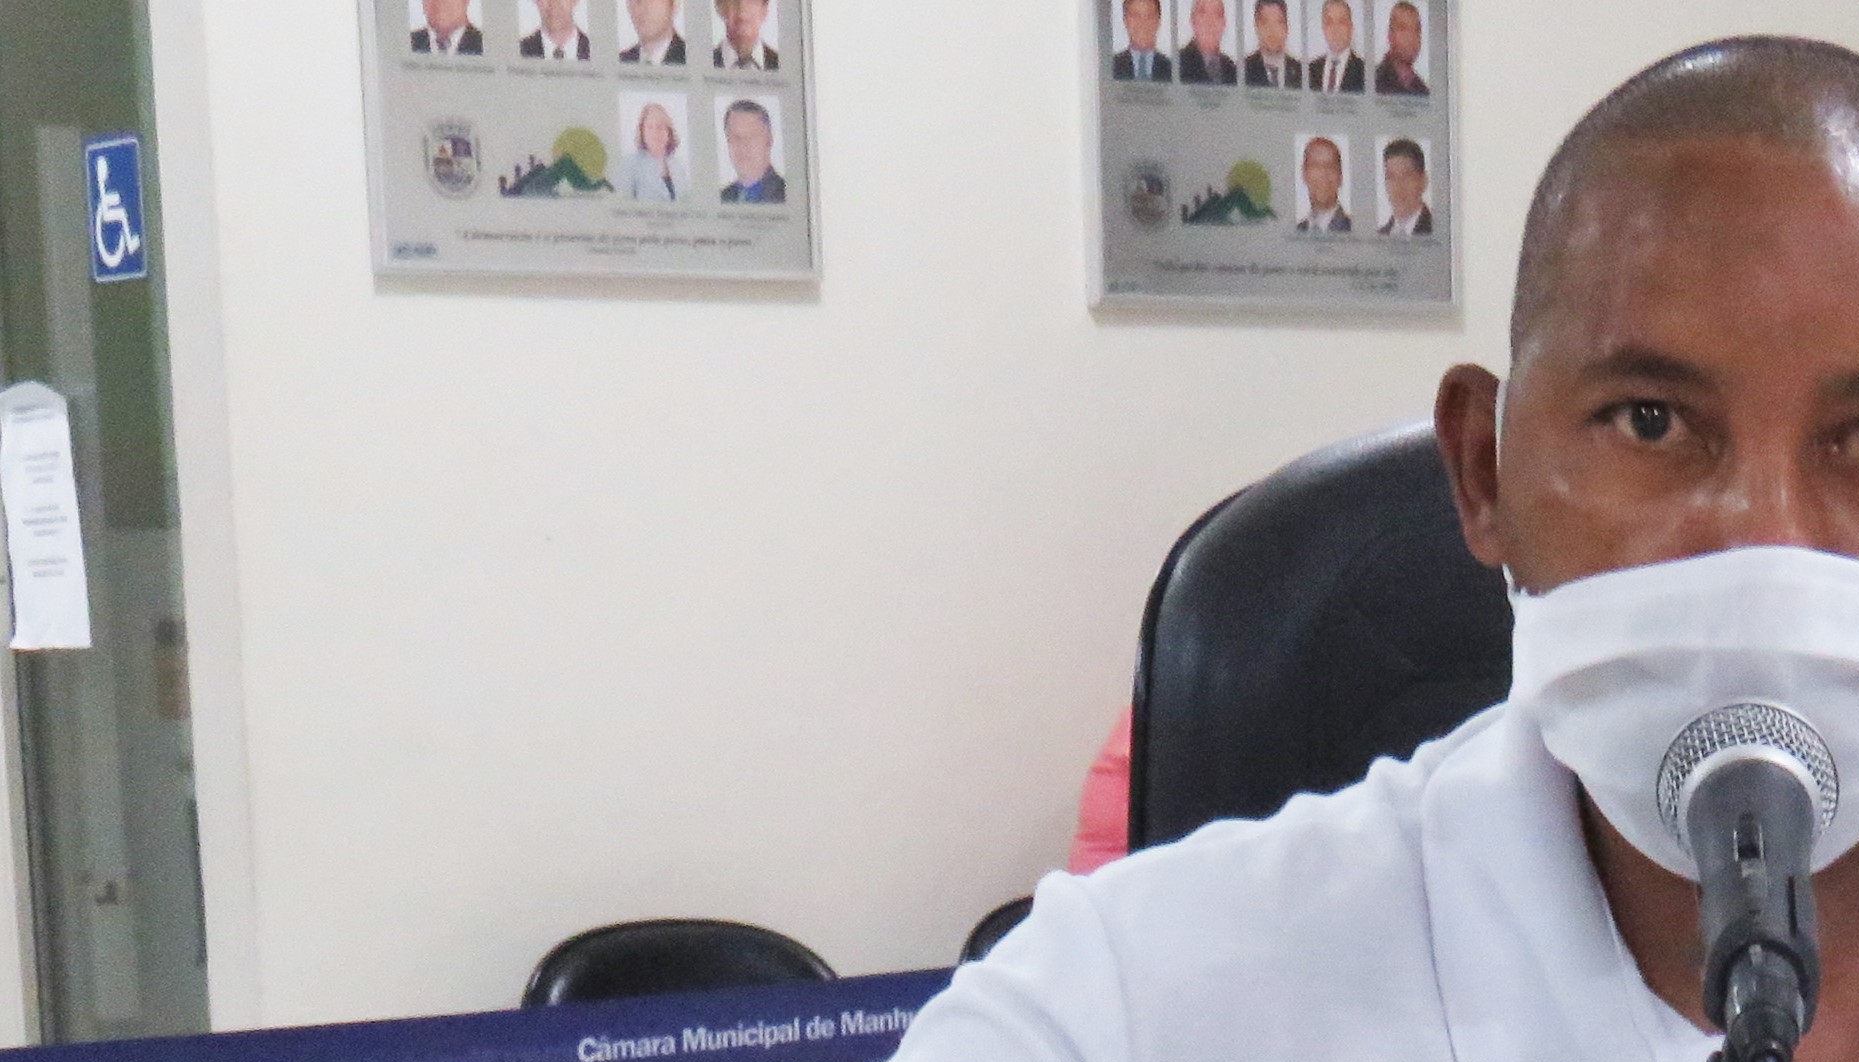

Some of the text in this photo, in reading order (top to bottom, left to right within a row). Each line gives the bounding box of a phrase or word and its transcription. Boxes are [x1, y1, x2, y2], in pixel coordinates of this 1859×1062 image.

[578, 1034, 677, 1062] Câmara
[682, 1017, 800, 1052] Municipal
[805, 1015, 835, 1040] de
